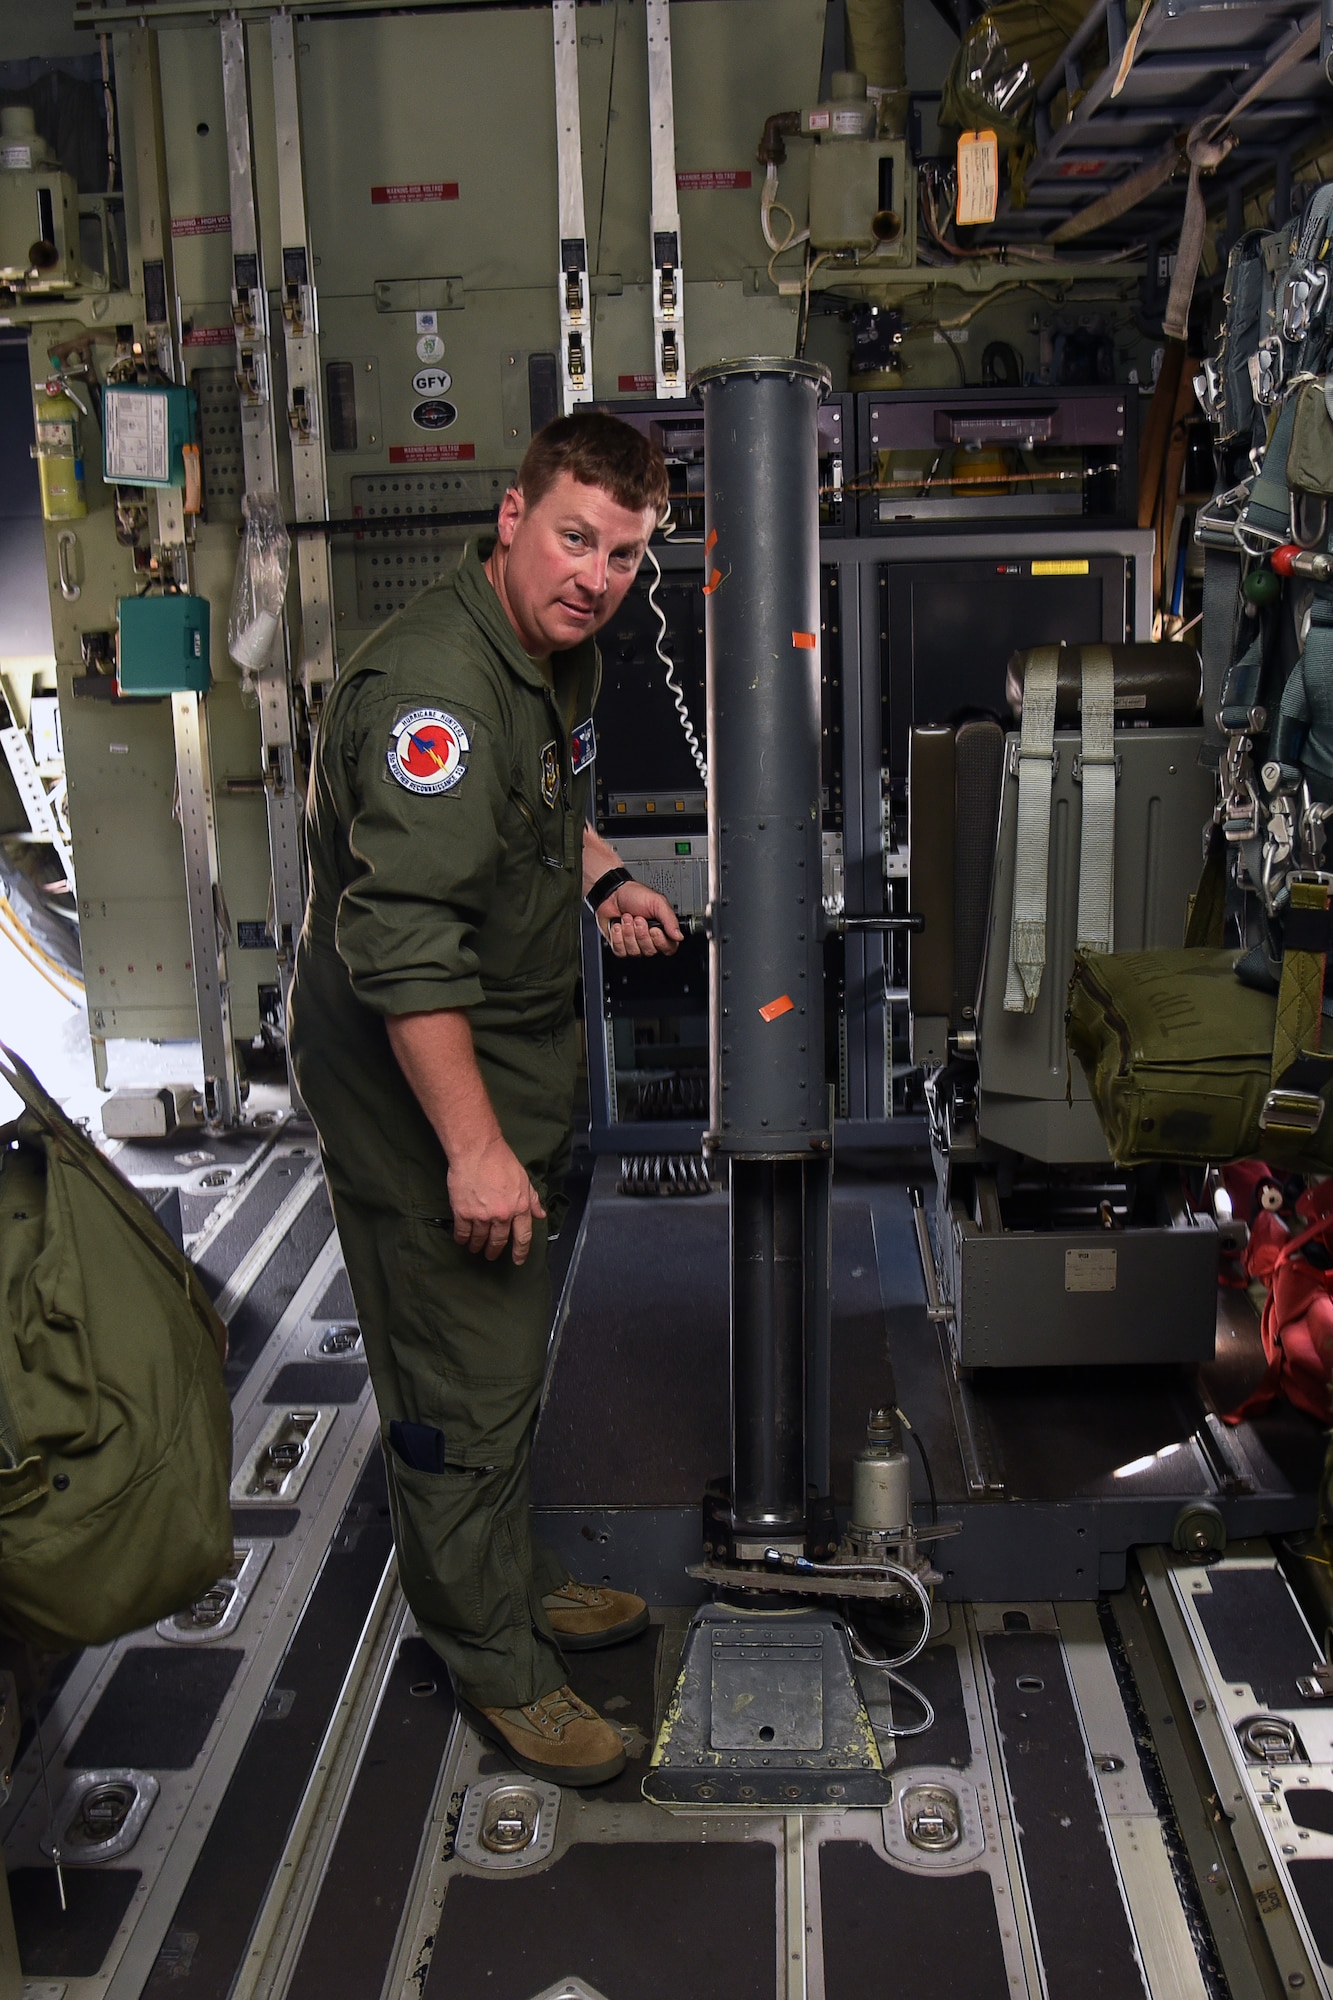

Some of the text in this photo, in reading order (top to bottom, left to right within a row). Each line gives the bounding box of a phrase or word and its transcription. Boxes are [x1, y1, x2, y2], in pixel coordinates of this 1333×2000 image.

[172, 219, 196, 228] ARNING
[217, 216, 231, 224] VOL
[416, 376, 447, 389] GFY
[402, 711, 464, 738] HURRICANE HUNTERS
[391, 763, 409, 785] WEATHER
[408, 775, 457, 792] RECONNAISSANCE
[1267, 1887, 1282, 1909] LOCK
